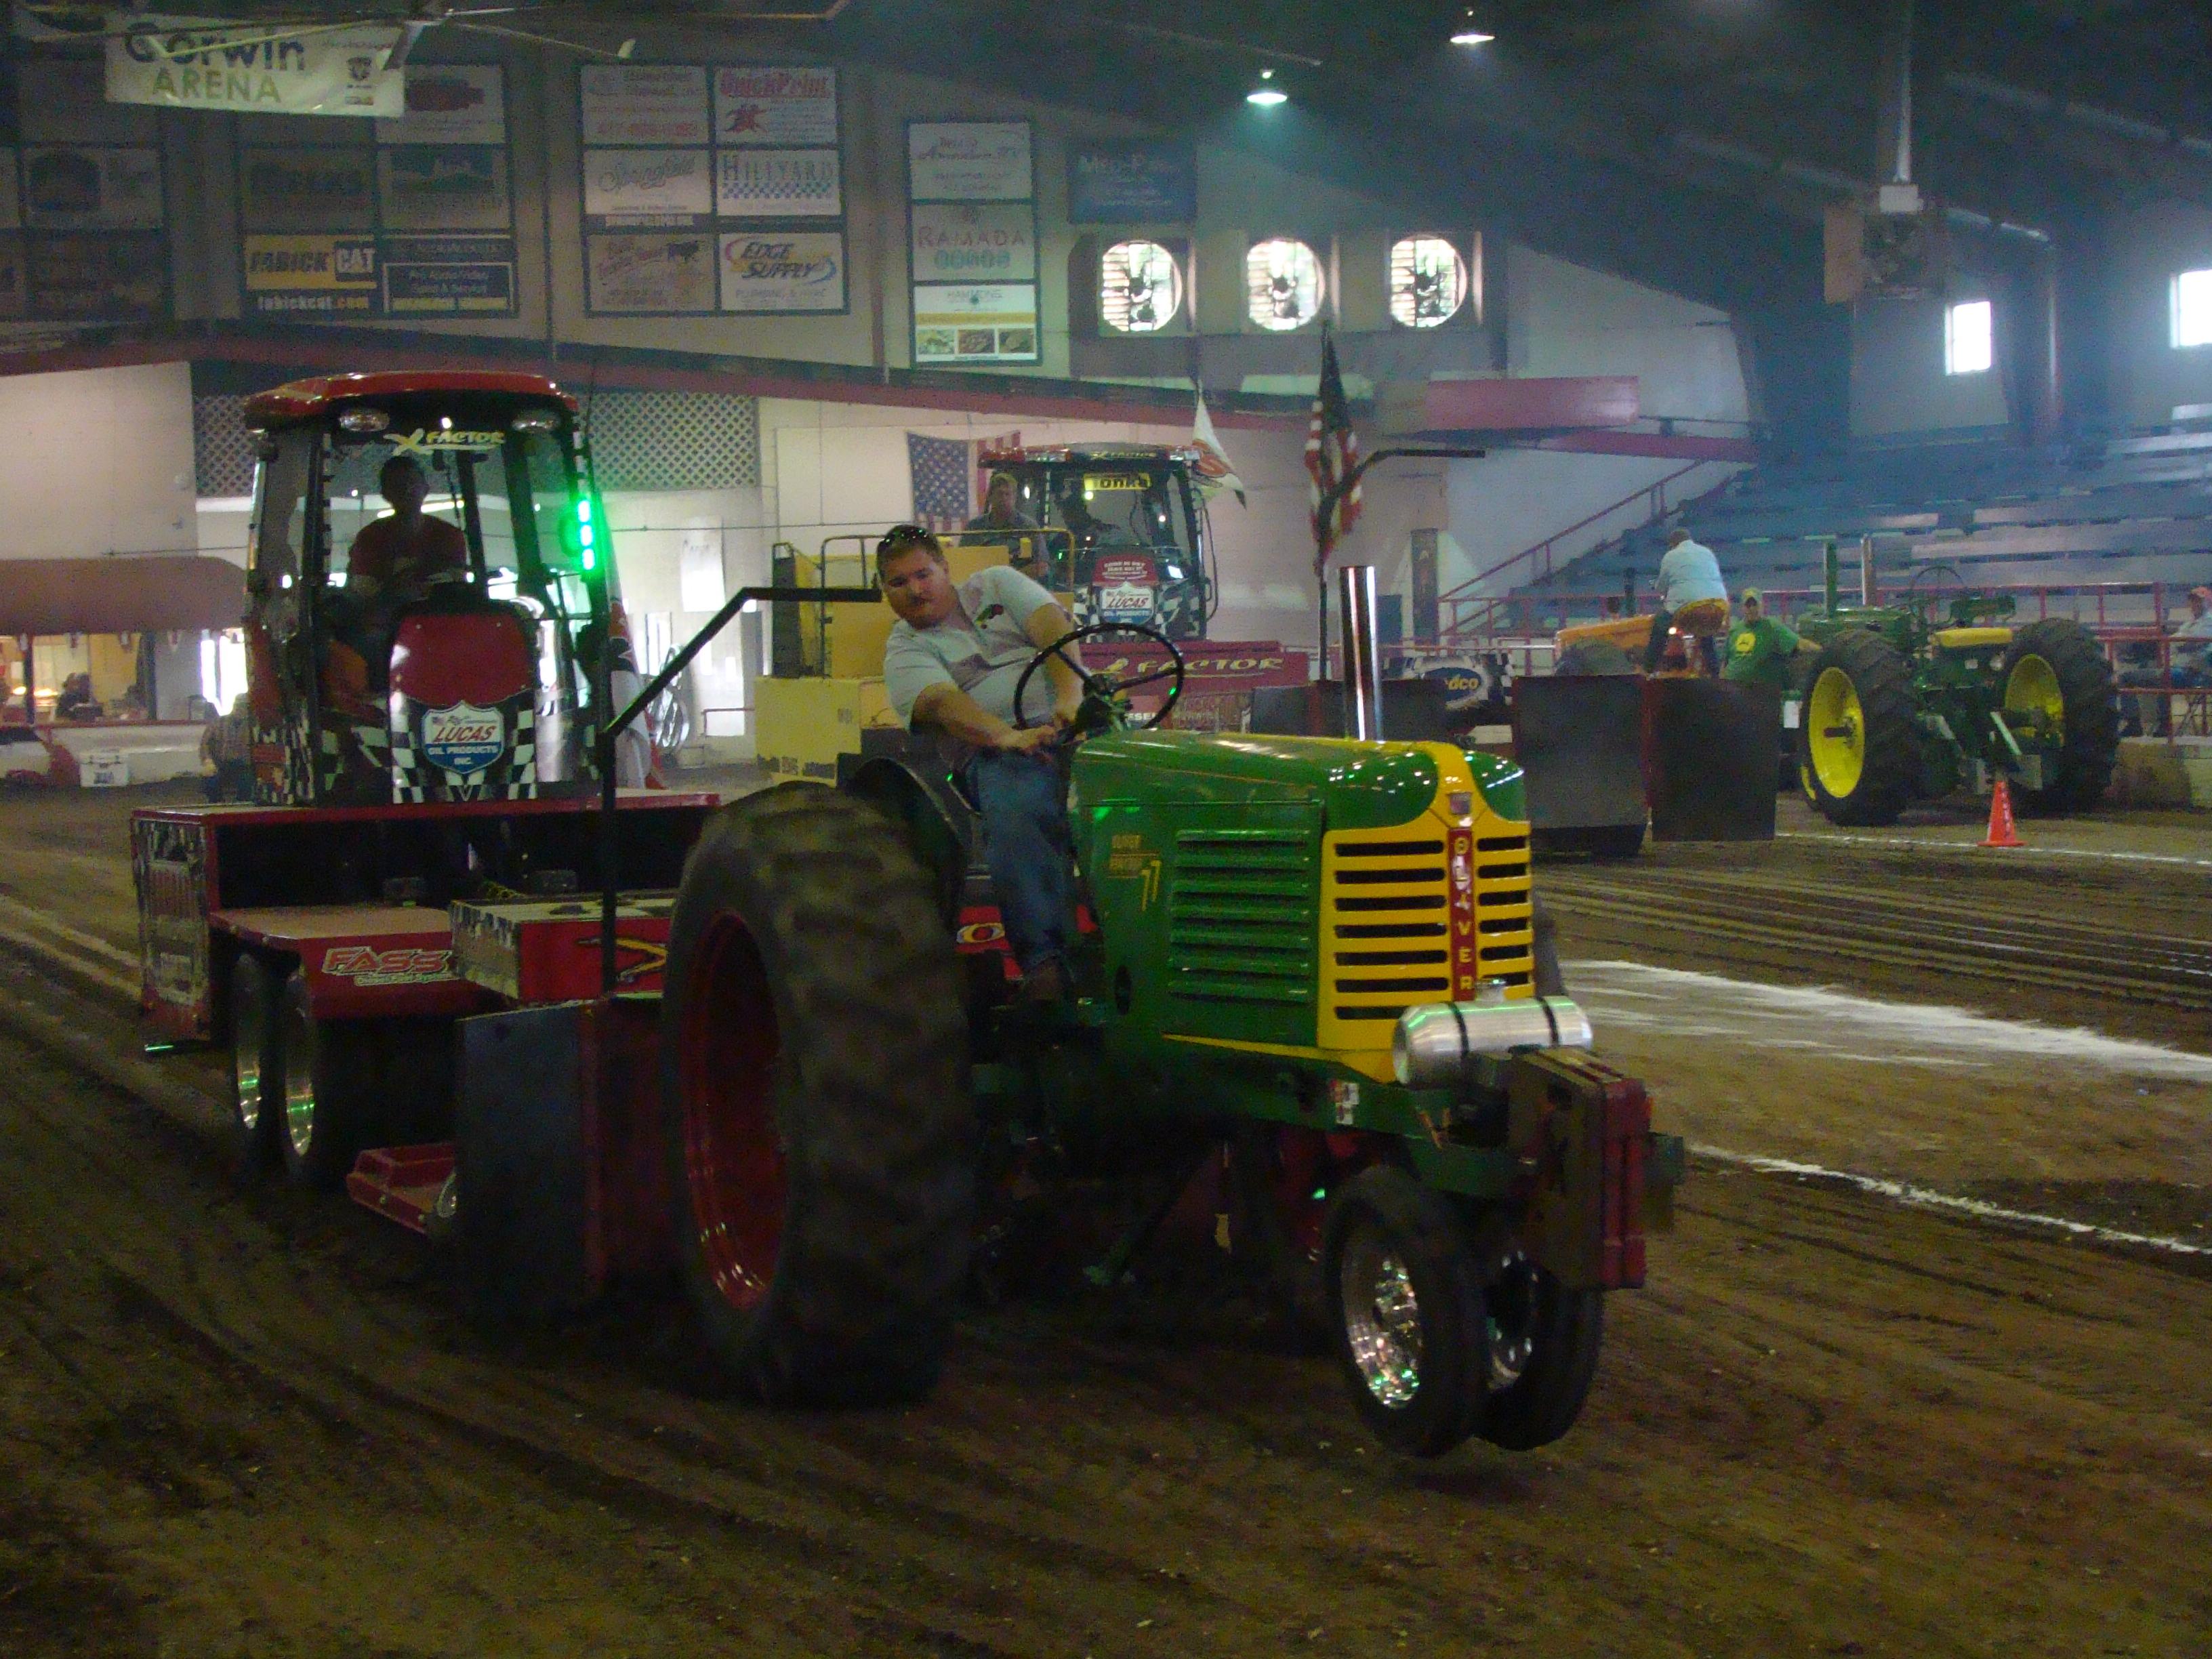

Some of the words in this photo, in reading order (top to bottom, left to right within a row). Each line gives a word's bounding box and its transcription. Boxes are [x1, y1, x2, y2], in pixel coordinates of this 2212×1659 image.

[152, 69, 281, 102] ARENA
[918, 226, 1025, 247] RAMADA
[335, 248, 375, 272] CAT
[426, 431, 505, 444] FACTOR
[1106, 597, 1149, 609] LUCAS
[1137, 657, 1284, 674] FACTOR
[432, 725, 497, 743] LUCAS
[322, 946, 453, 976] FASS
